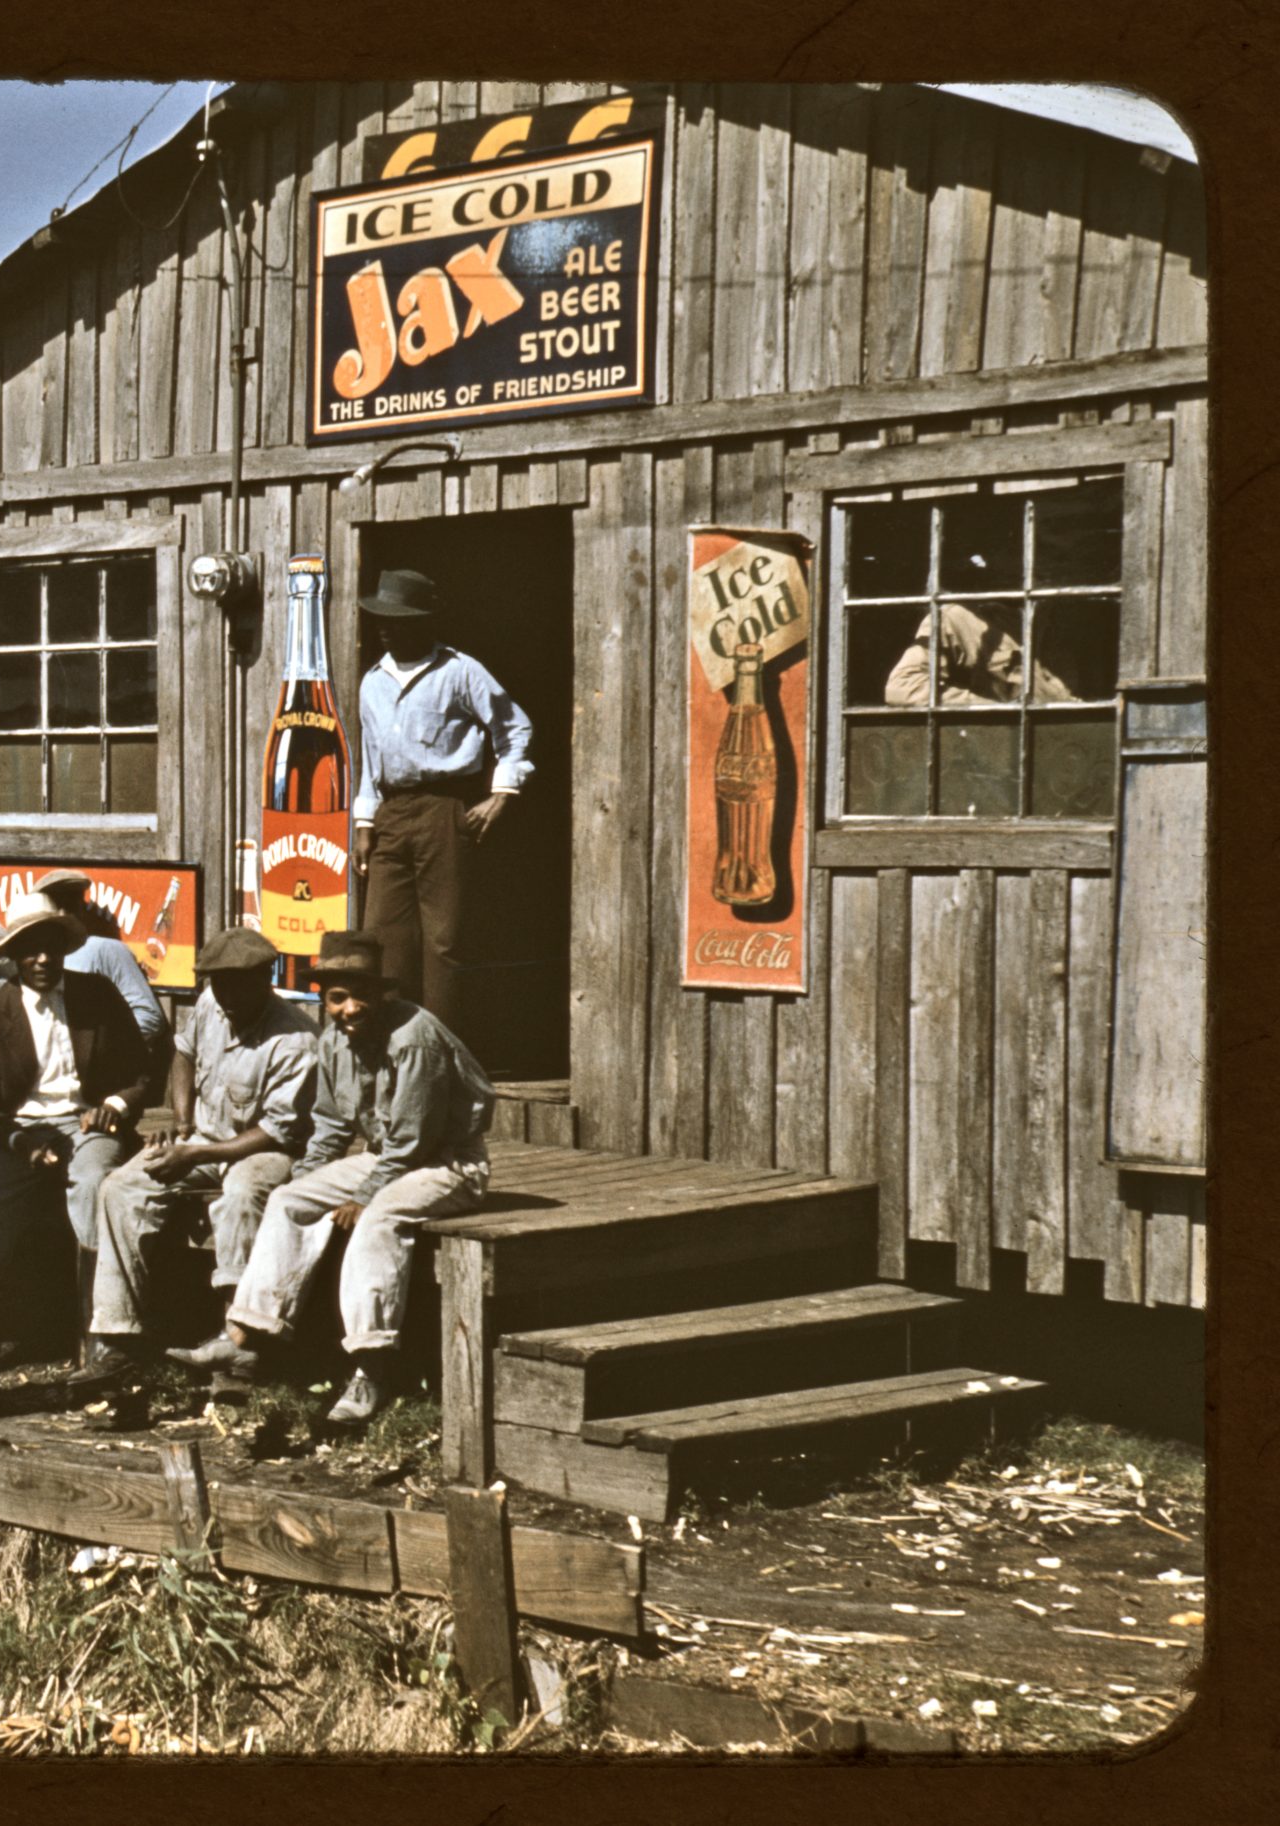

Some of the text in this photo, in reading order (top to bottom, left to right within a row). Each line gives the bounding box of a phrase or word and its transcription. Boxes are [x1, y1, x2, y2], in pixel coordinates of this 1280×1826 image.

[345, 169, 612, 245] ICE COLD
[563, 240, 622, 278] ALE
[333, 227, 524, 398] Jax
[540, 281, 621, 321] BEER
[519, 321, 621, 363] STOUT
[330, 365, 627, 421] THE DRINKS OF FRIENDSHIP
[704, 556, 774, 613] Ice
[709, 580, 802, 660] Cold
[262, 833, 347, 875] ROYAL CROWN
[278, 915, 326, 933] COLA
